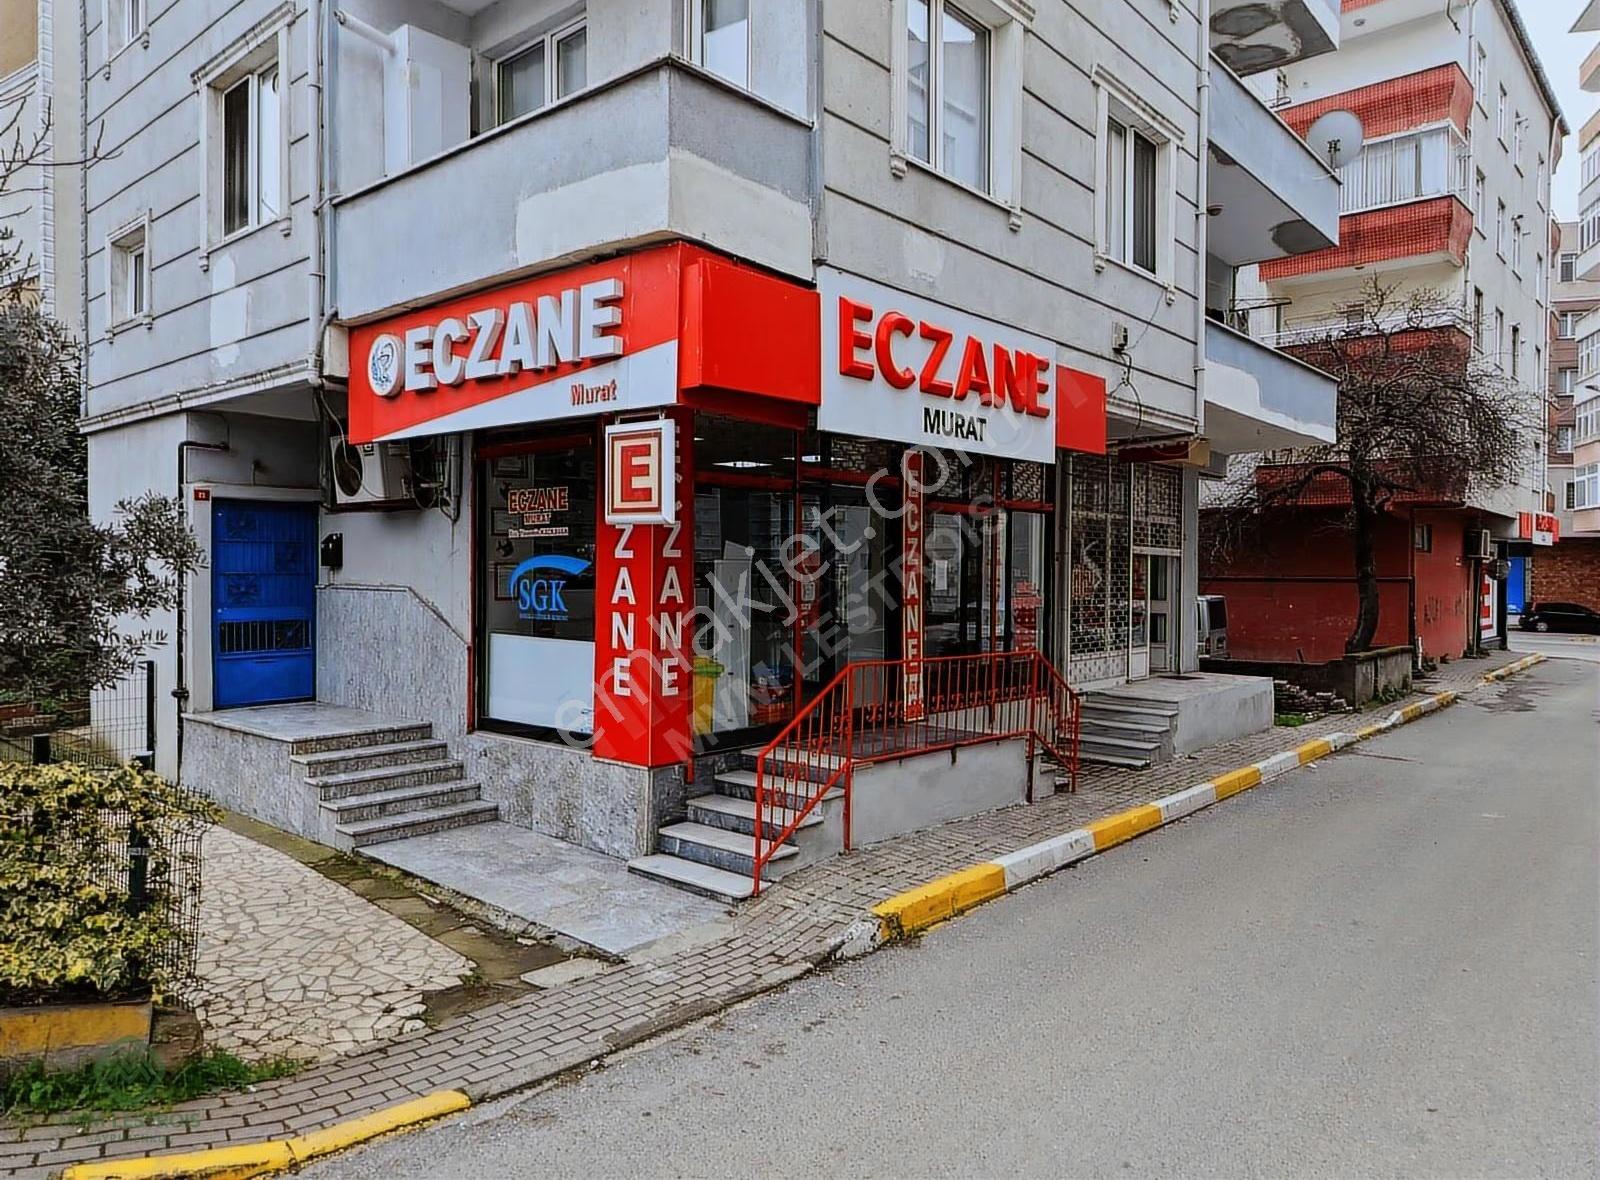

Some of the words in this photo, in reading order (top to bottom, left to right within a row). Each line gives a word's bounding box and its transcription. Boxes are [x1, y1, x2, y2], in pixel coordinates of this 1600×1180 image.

[404, 278, 623, 392] ECZANE
[838, 295, 1051, 419] ECZANE
[571, 378, 617, 406] Murat
[923, 406, 986, 442] MURAT
[620, 444, 652, 502] E
[508, 486, 569, 514] ECZANE
[519, 579, 568, 612] SGK
